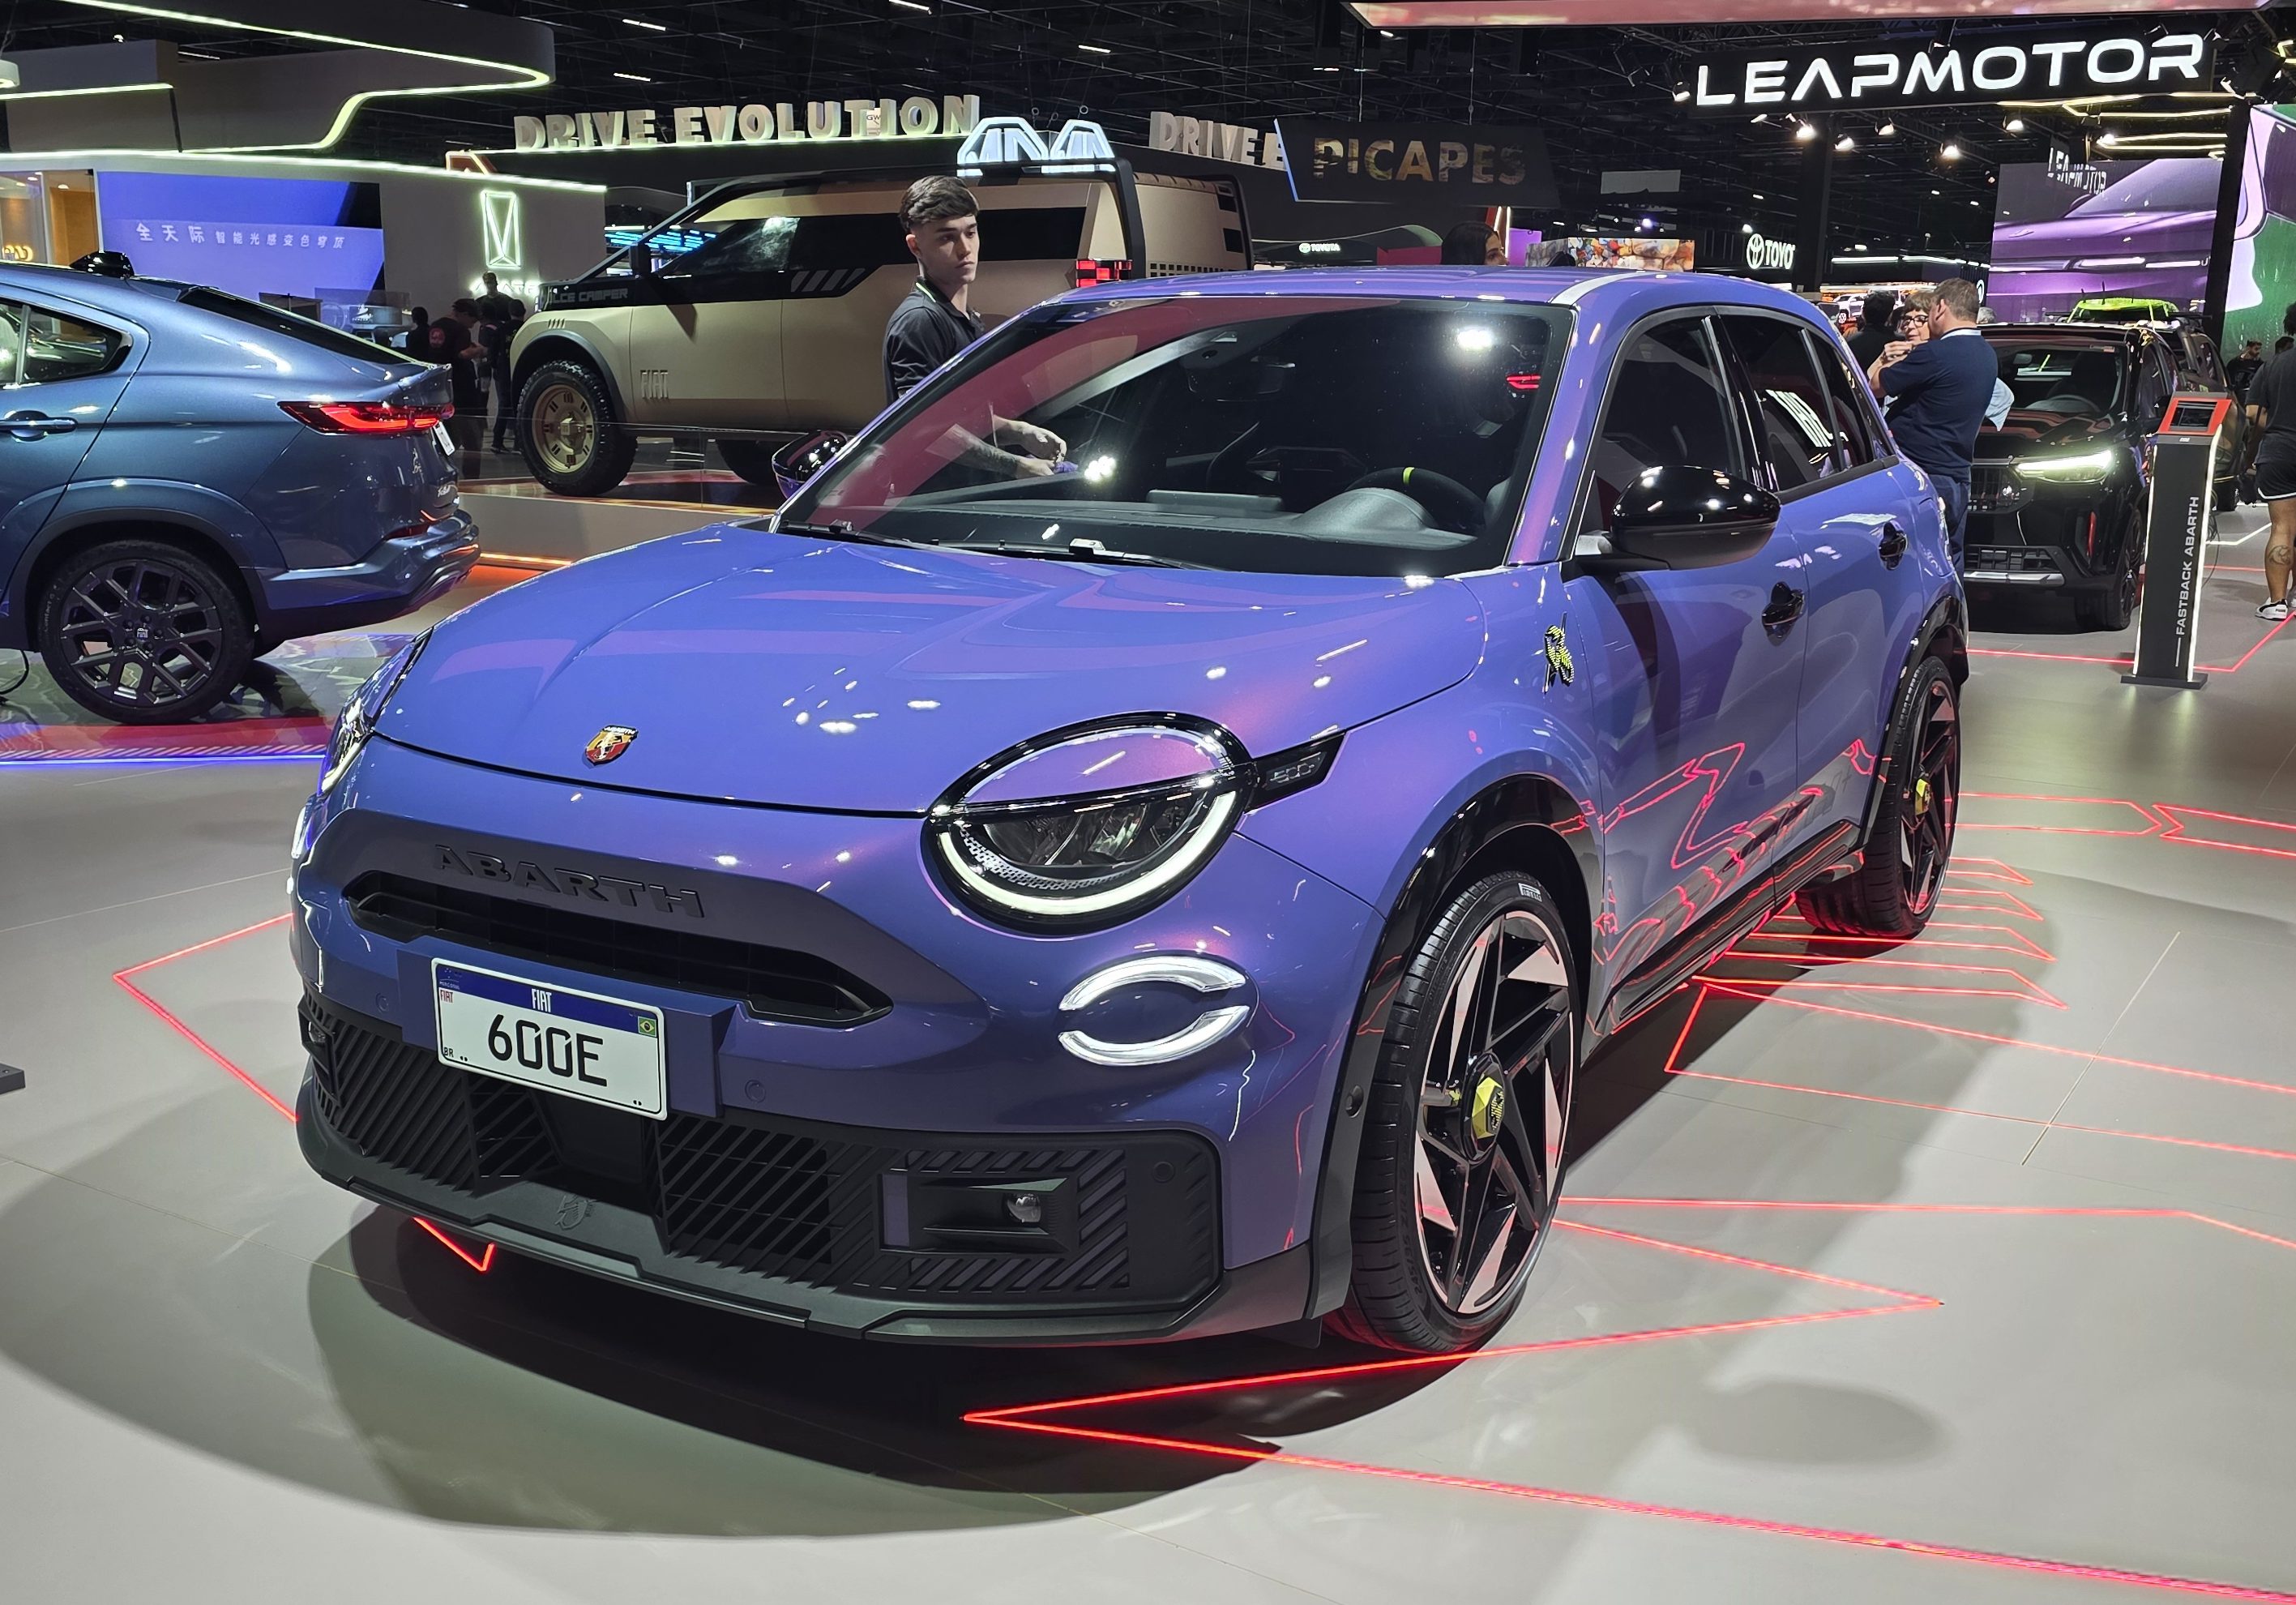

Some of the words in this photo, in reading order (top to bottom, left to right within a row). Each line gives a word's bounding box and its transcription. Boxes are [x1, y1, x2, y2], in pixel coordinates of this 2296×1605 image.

[1696, 33, 2204, 106] LEAPMOTOR
[514, 109, 657, 150] DRIVE
[673, 95, 979, 143] EVOLUTION
[1149, 111, 1259, 166] DRIVE
[1262, 132, 1288, 171] E
[1314, 137, 1527, 186] PICAPES
[135, 222, 205, 244] 全天际
[1765, 239, 1796, 270] TOYO
[639, 370, 669, 399] FIAT
[2183, 496, 2200, 557] ABARTH
[2175, 561, 2193, 636] FASTBACK
[433, 844, 704, 918] ABARTH
[439, 989, 454, 1004] FIAT
[531, 987, 552, 1013] FIAT
[443, 1046, 454, 1058] BR
[488, 1013, 608, 1088] 600E
